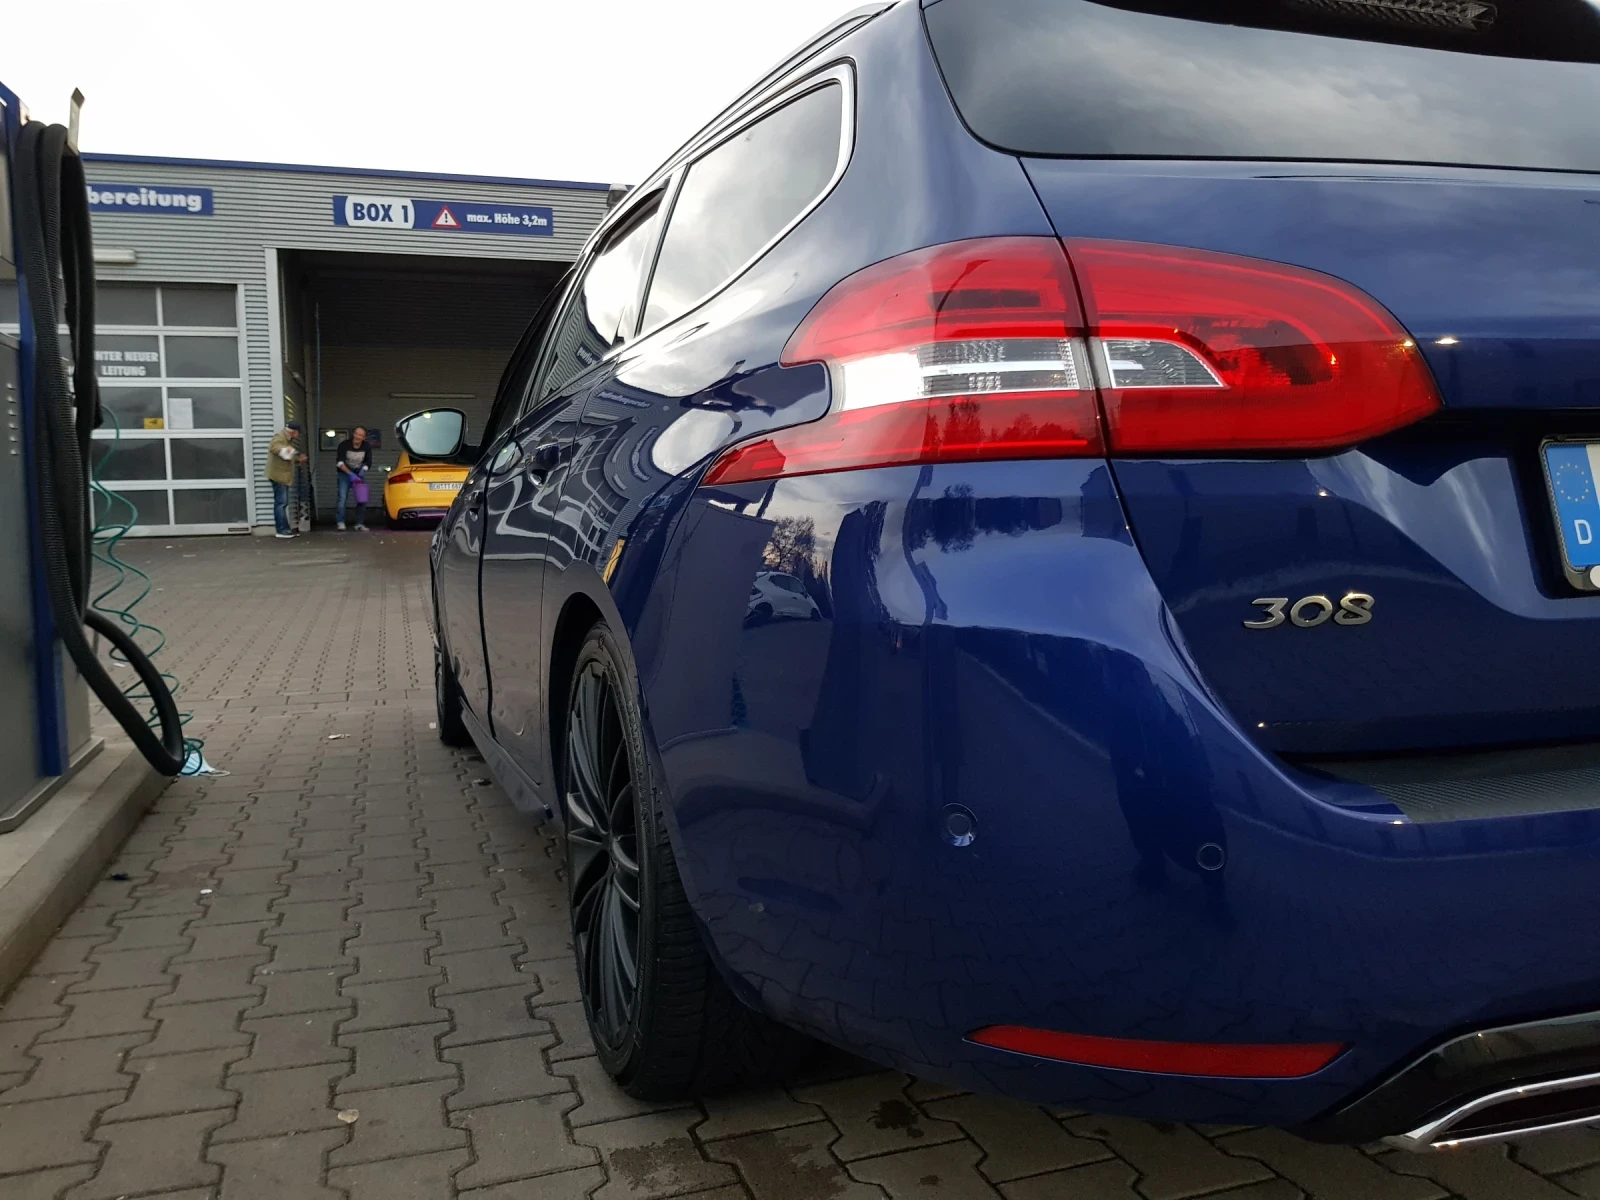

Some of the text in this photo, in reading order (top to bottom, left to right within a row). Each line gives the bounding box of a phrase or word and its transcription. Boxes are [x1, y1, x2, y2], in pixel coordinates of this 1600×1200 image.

[86, 185, 203, 212] bereitung
[352, 202, 409, 223] BOX 1
[466, 212, 547, 227] max. Höhe 3,2m
[95, 350, 159, 362] NTER NEUER
[101, 365, 146, 376] LEITUNG
[1573, 519, 1593, 545] D
[1243, 593, 1375, 629] 308
